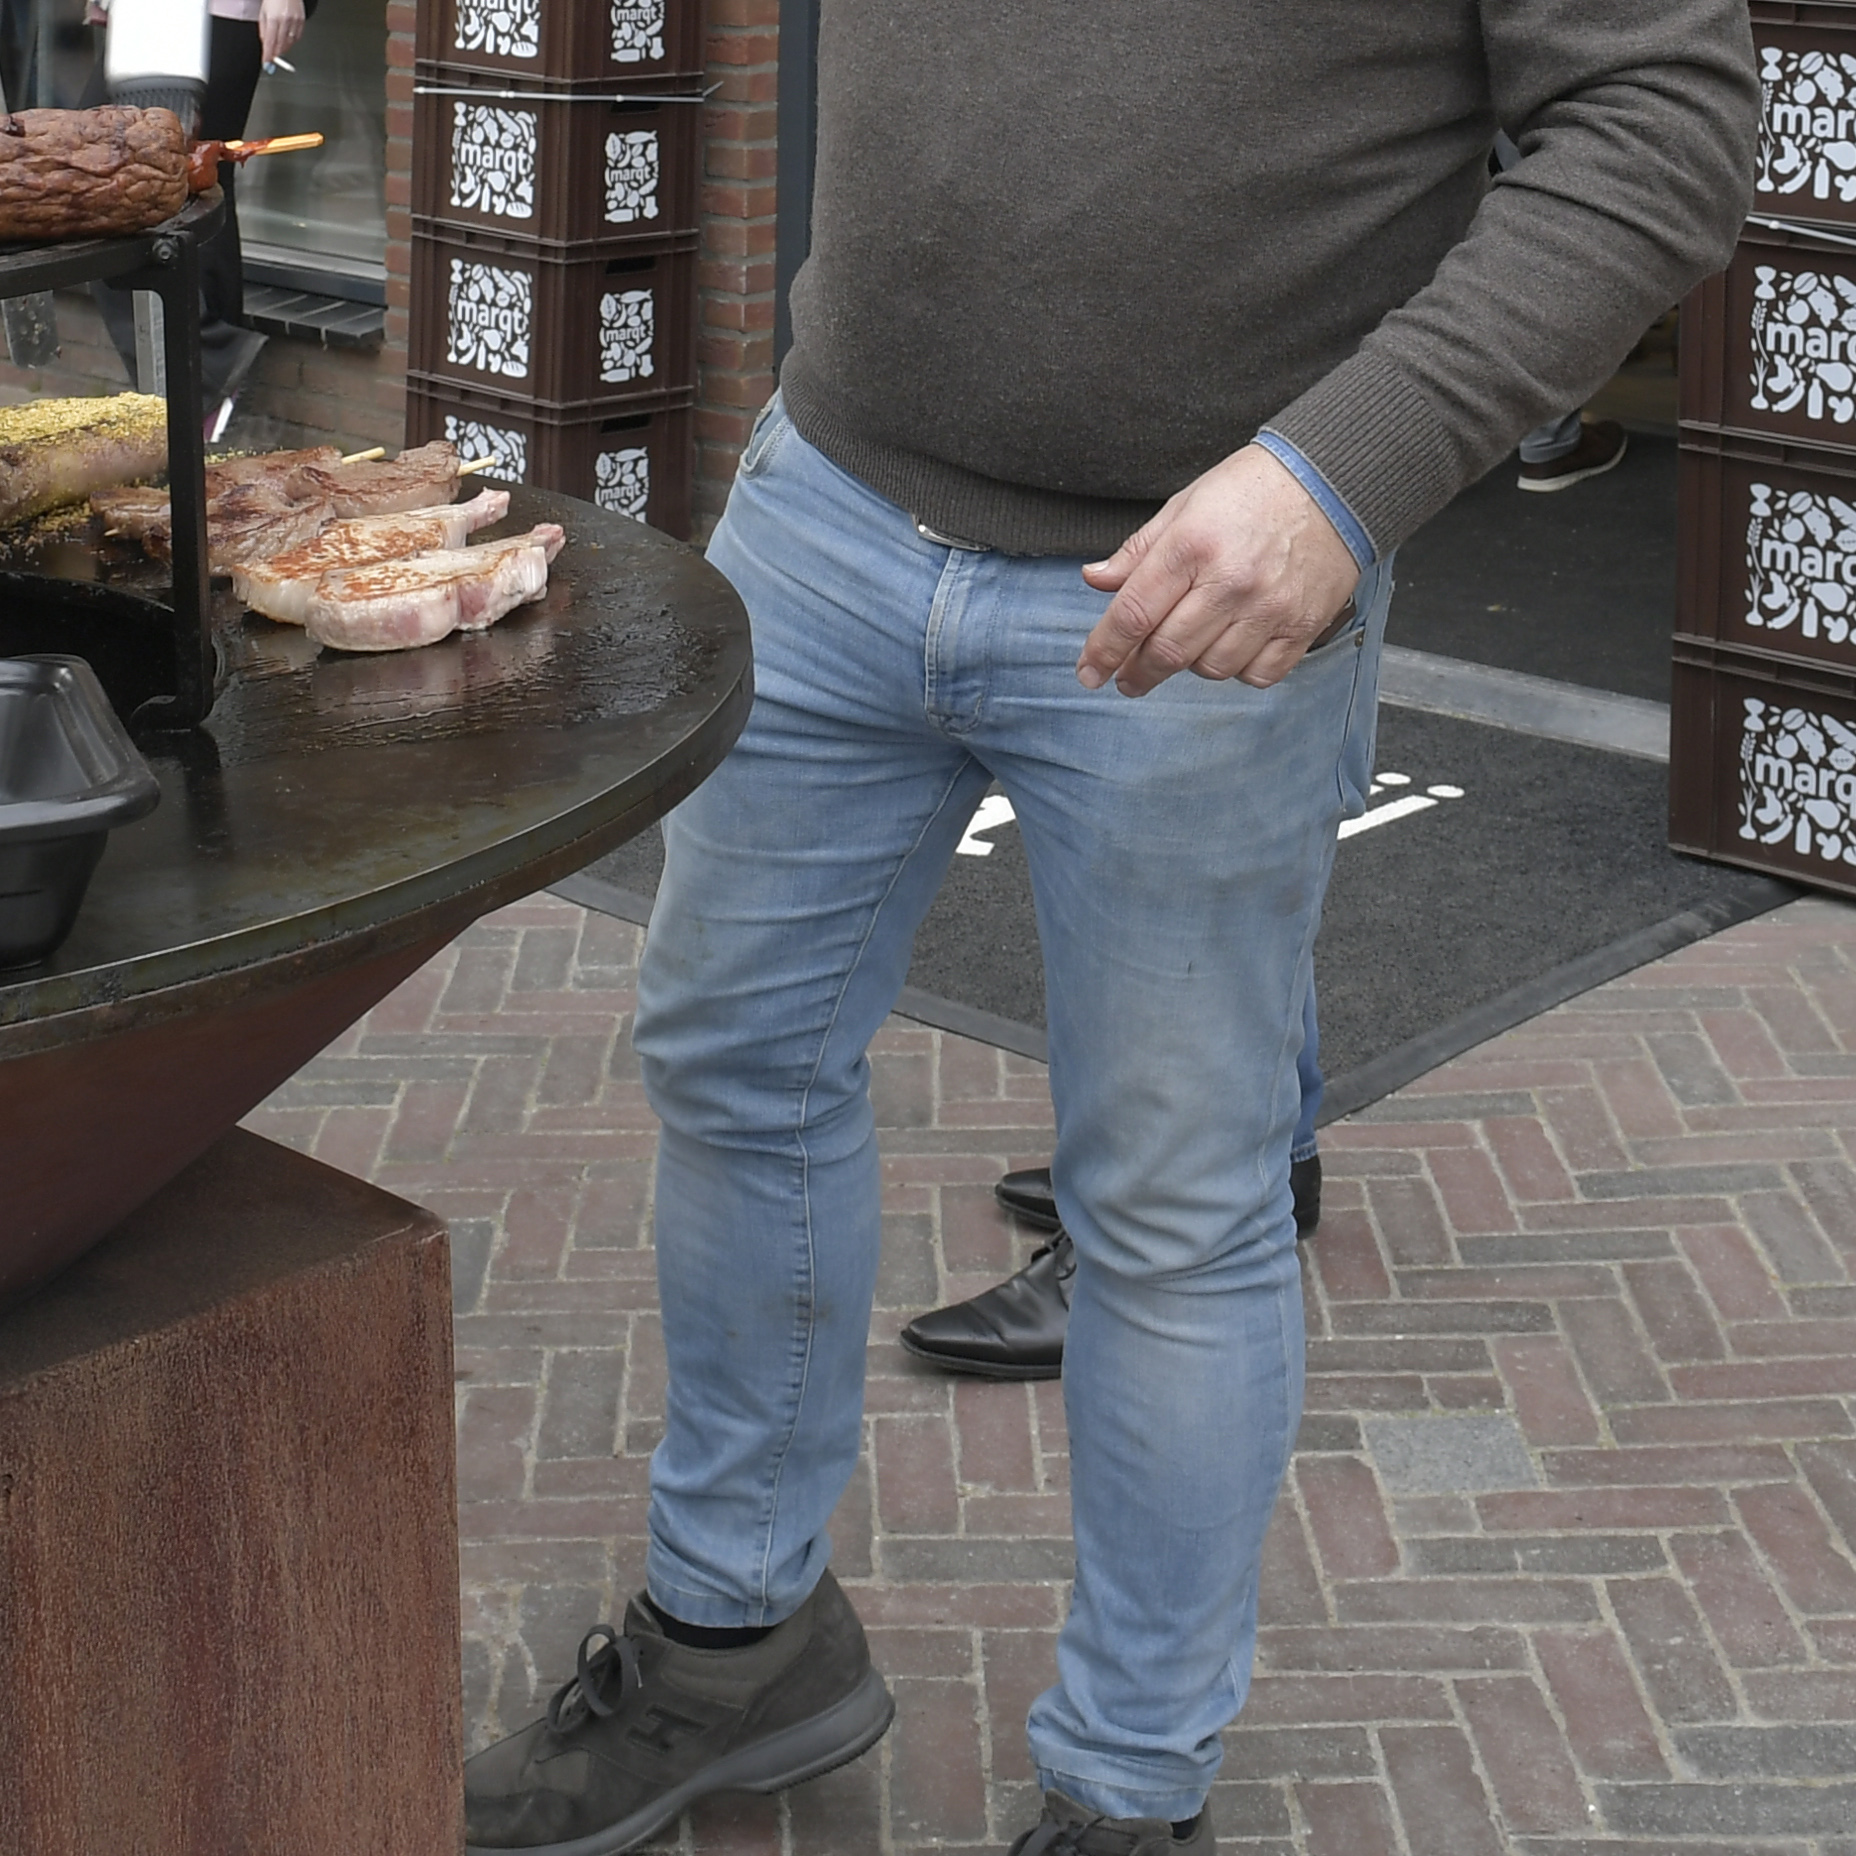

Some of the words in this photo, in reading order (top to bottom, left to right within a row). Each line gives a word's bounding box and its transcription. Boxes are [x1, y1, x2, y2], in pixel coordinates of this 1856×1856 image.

[617, 5, 658, 24] marqt
[461, 142, 527, 184] marqt
[610, 164, 651, 185] marqt
[457, 298, 523, 342] marqt
[605, 324, 646, 346] marqt
